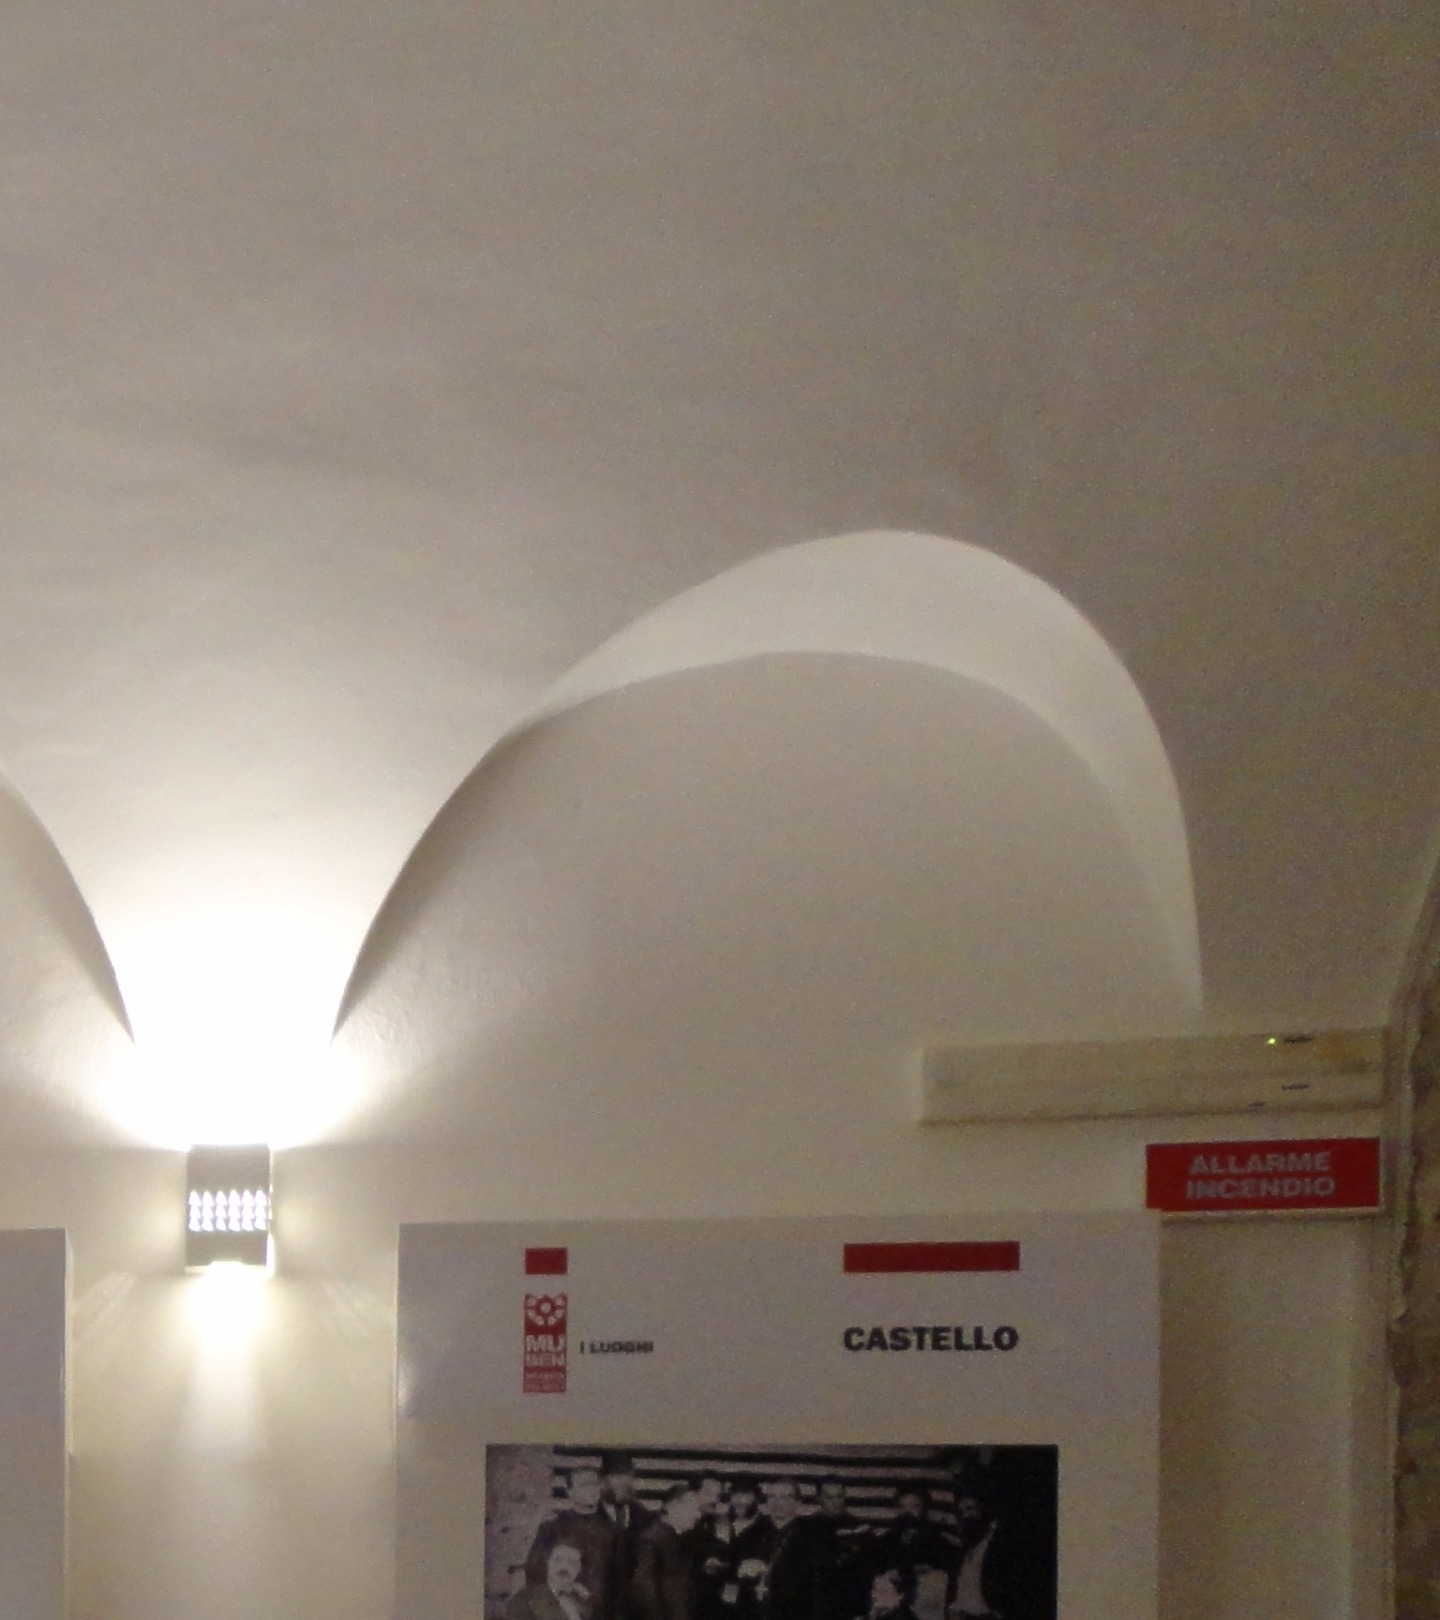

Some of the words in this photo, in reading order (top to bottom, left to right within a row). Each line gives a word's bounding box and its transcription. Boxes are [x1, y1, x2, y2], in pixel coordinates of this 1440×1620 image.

[1189, 1152, 1331, 1176] ALLARME
[1185, 1176, 1335, 1200] INCENDIO
[843, 1325, 1019, 1352] CASTELLO
